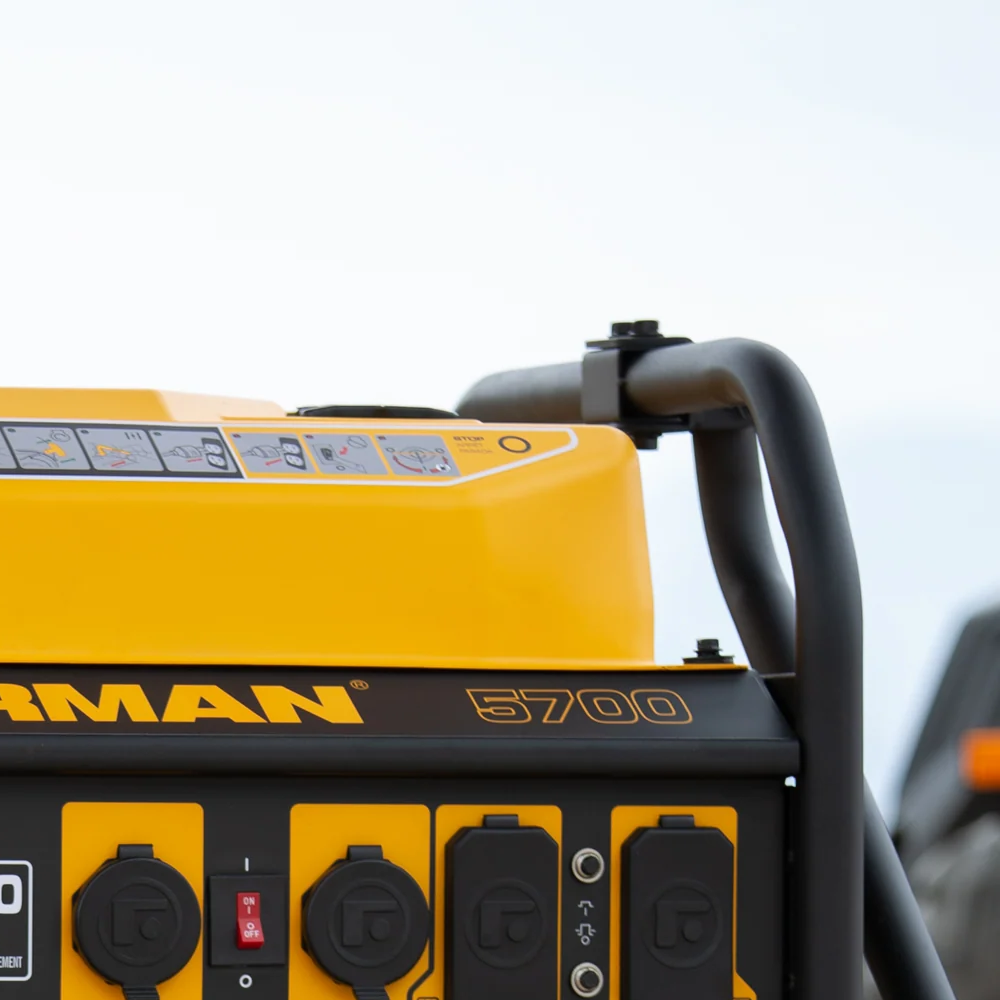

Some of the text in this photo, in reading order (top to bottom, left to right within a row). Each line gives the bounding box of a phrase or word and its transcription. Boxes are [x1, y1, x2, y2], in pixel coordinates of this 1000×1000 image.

[465, 688, 693, 725] 5700
[243, 897, 255, 905] ON
[244, 930, 260, 938] OFF
